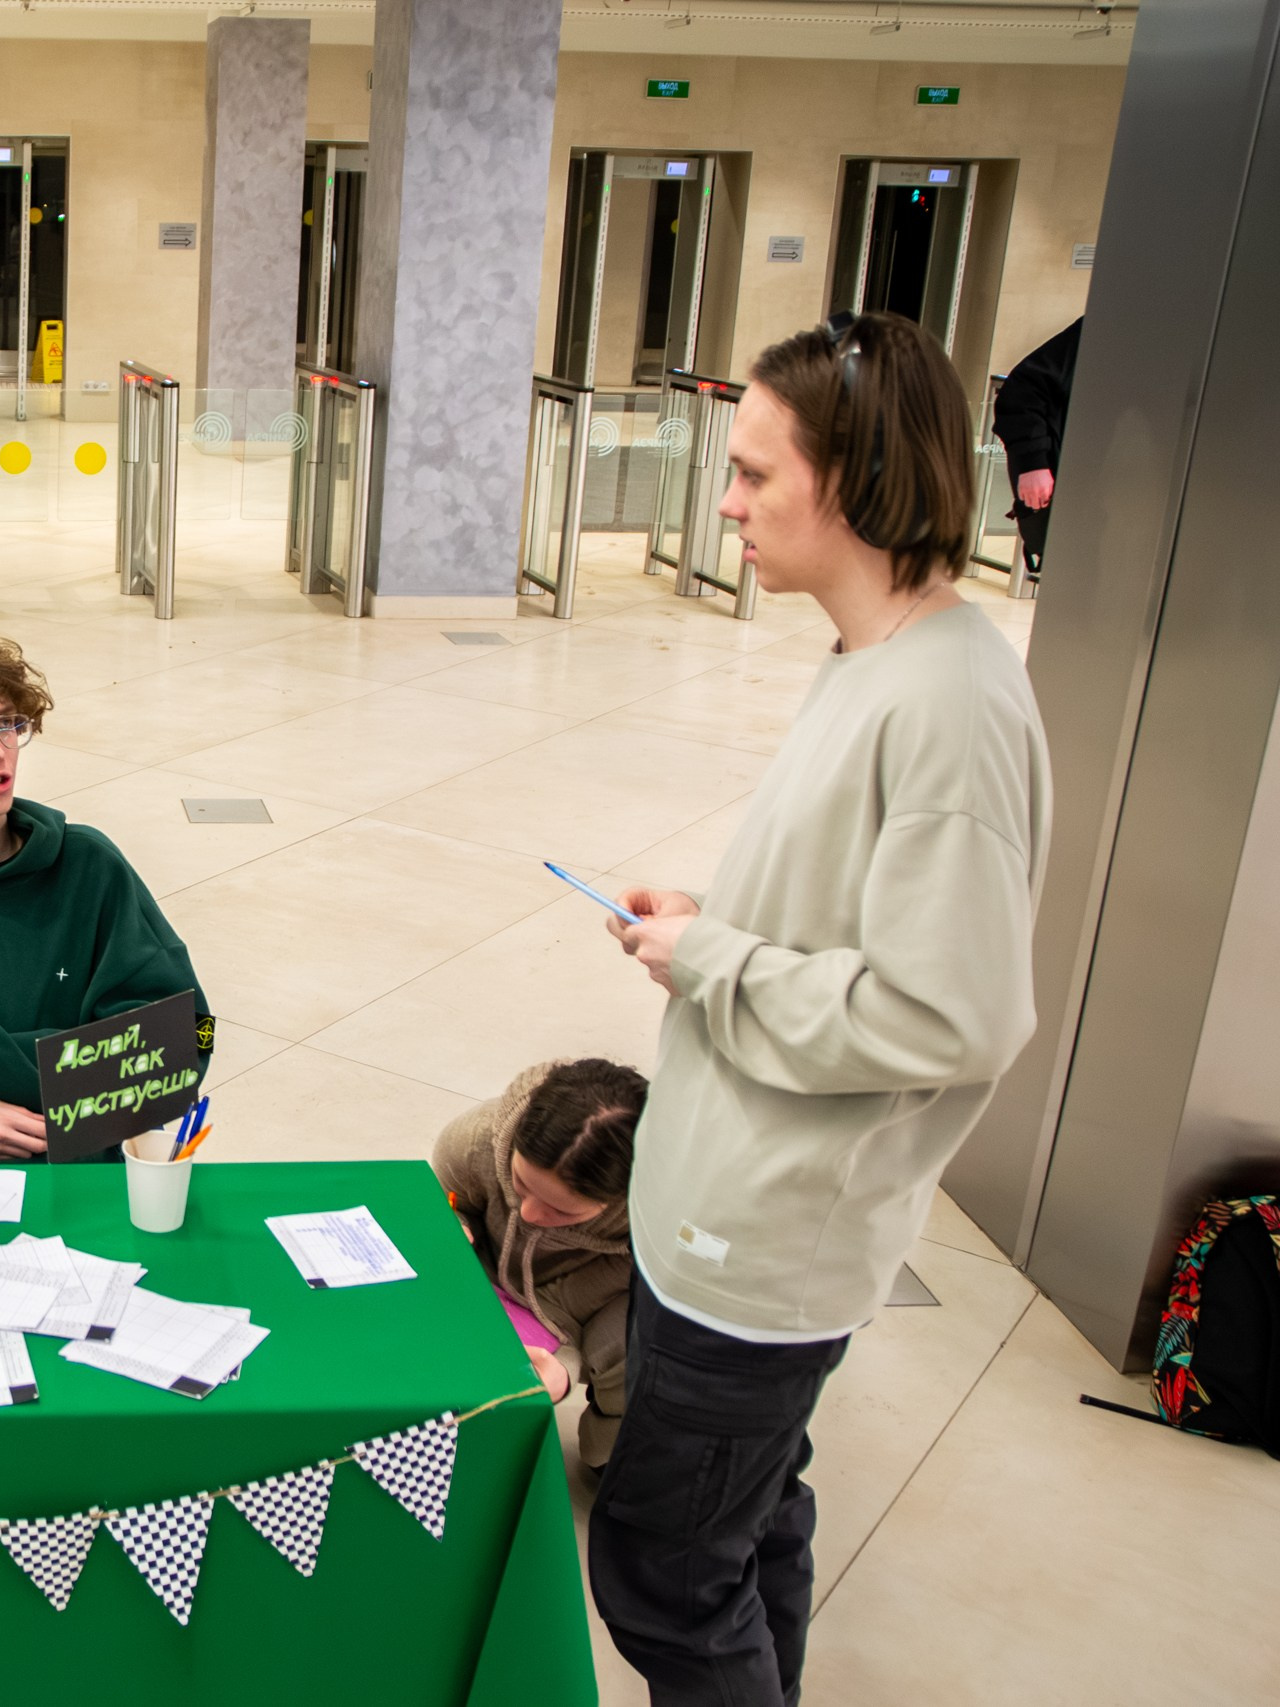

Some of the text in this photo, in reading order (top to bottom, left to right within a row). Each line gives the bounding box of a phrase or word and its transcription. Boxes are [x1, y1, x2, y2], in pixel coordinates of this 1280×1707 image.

[55, 1023, 147, 1074] Делай,
[119, 1046, 165, 1079] как
[48, 1068, 199, 1132] чувствуешь
